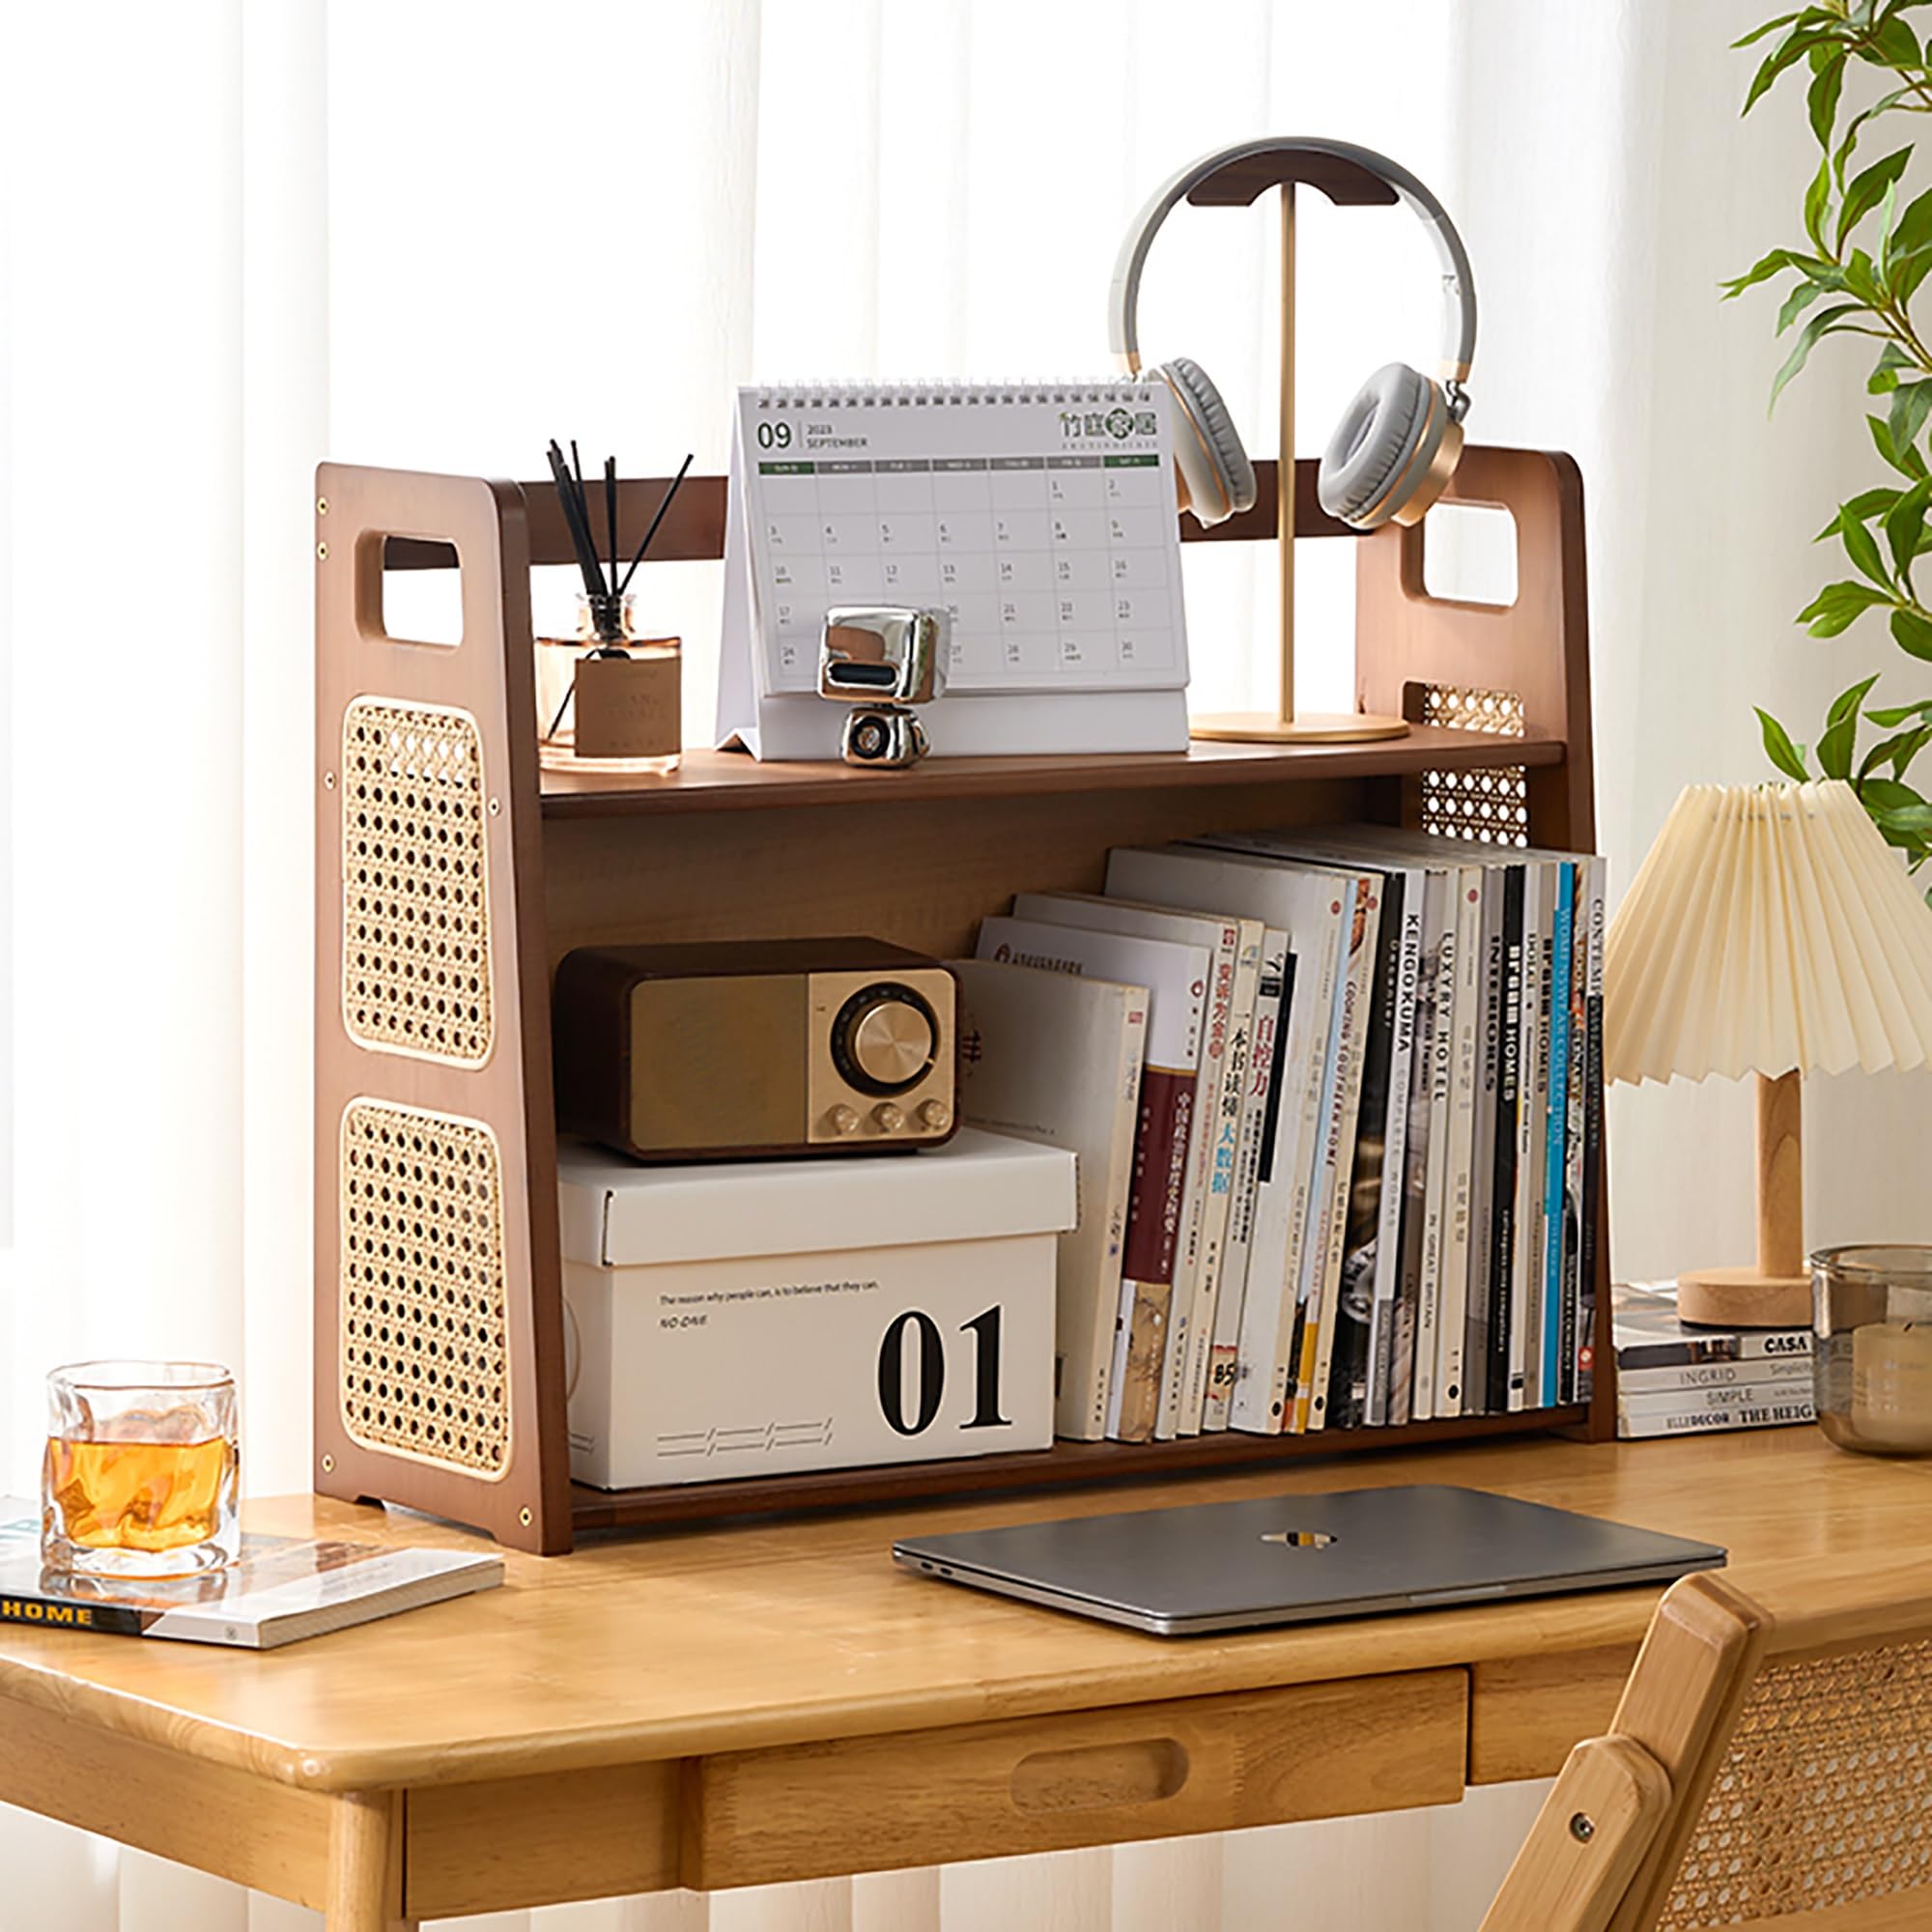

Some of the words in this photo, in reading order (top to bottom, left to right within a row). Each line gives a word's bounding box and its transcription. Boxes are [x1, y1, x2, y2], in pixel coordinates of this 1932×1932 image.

[758, 421, 791, 449] 09
[807, 438, 867, 448] SEPTEMBER
[1434, 1030, 1450, 1102] HOTEL
[1764, 1336, 1808, 1353] CASA
[877, 1304, 1012, 1436] 01
[1680, 1368, 1737, 1385] INGRID
[1706, 1388, 1754, 1406] SIMPLE
[1740, 1406, 1772, 1425] THE
[2, 1601, 94, 1626] HOME
